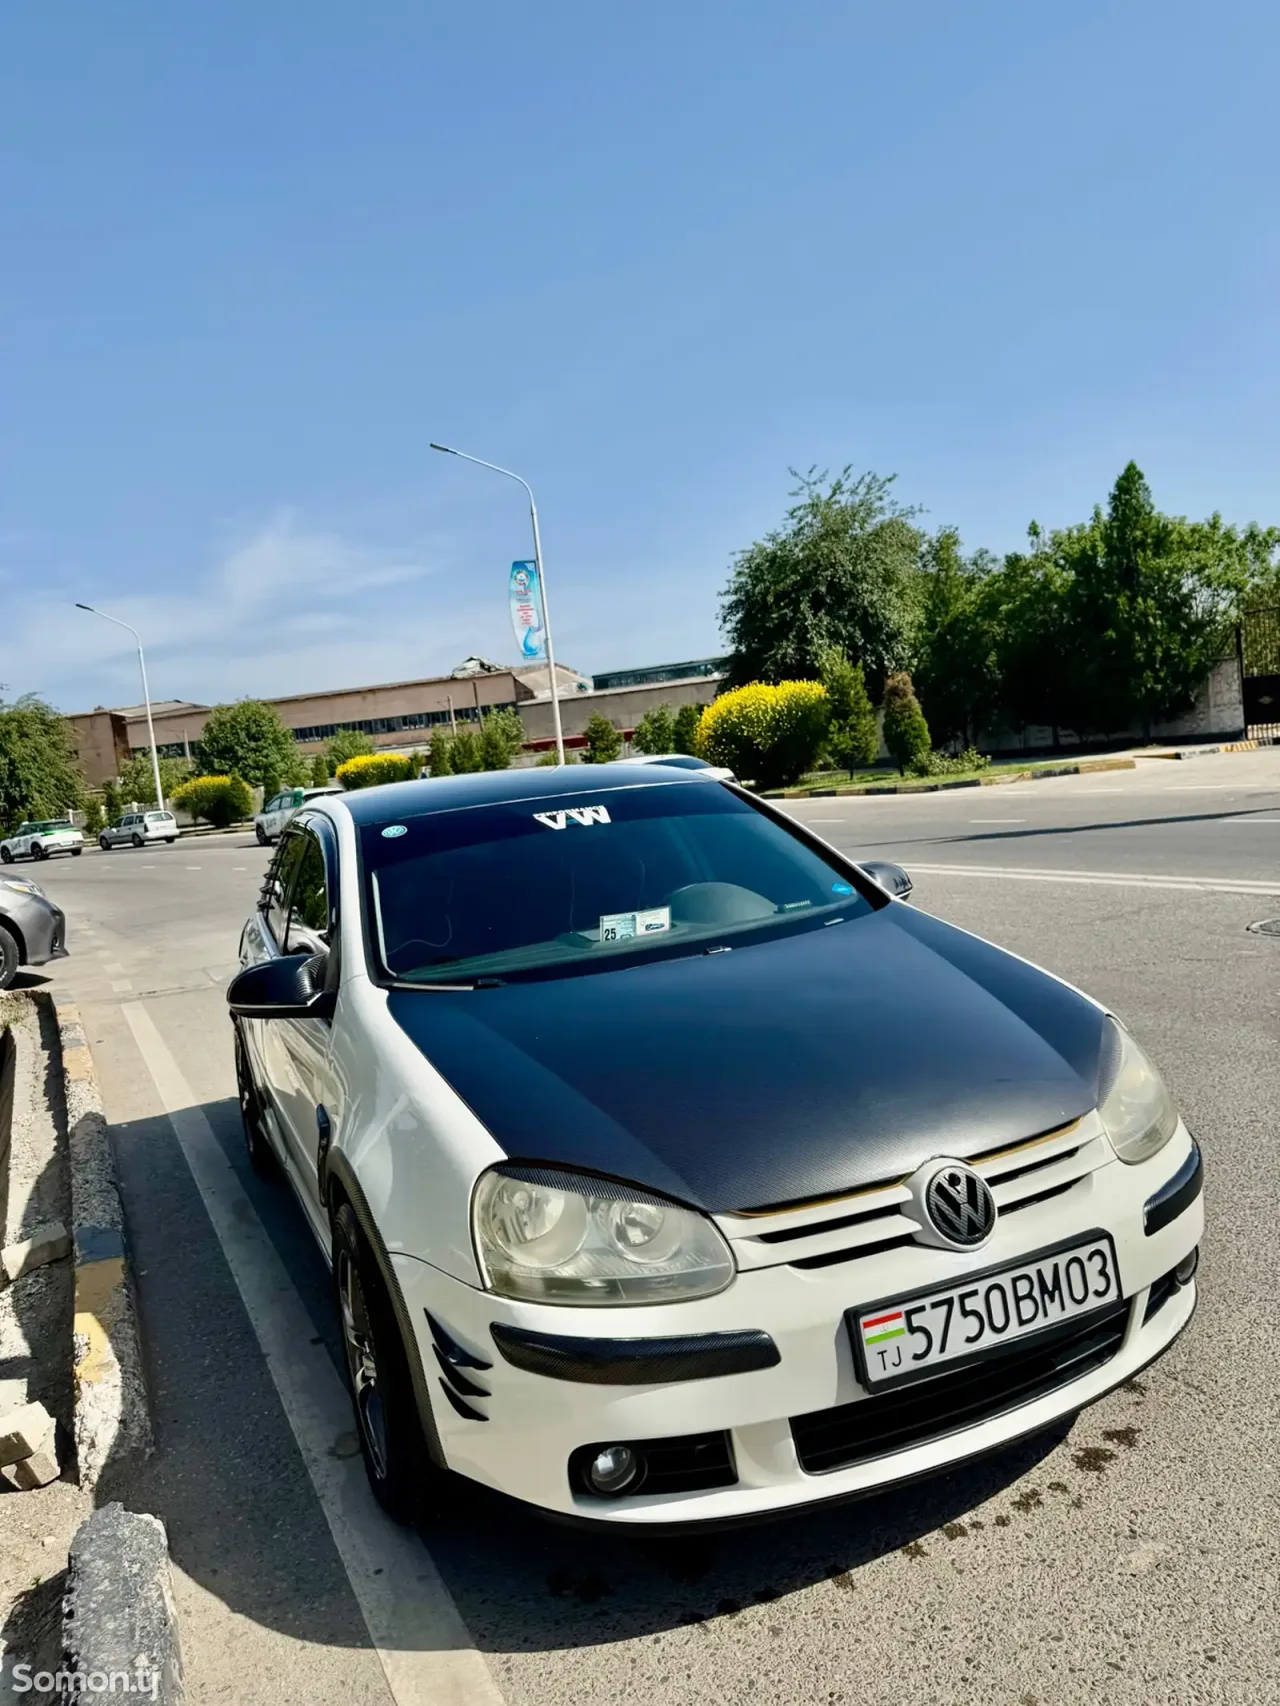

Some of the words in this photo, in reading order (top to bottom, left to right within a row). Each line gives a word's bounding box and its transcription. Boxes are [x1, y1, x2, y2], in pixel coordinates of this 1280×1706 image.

[533, 805, 612, 830] VW
[604, 928, 617, 941] 25
[904, 1248, 1112, 1362] 5750BM03
[877, 1345, 902, 1371] TJ
